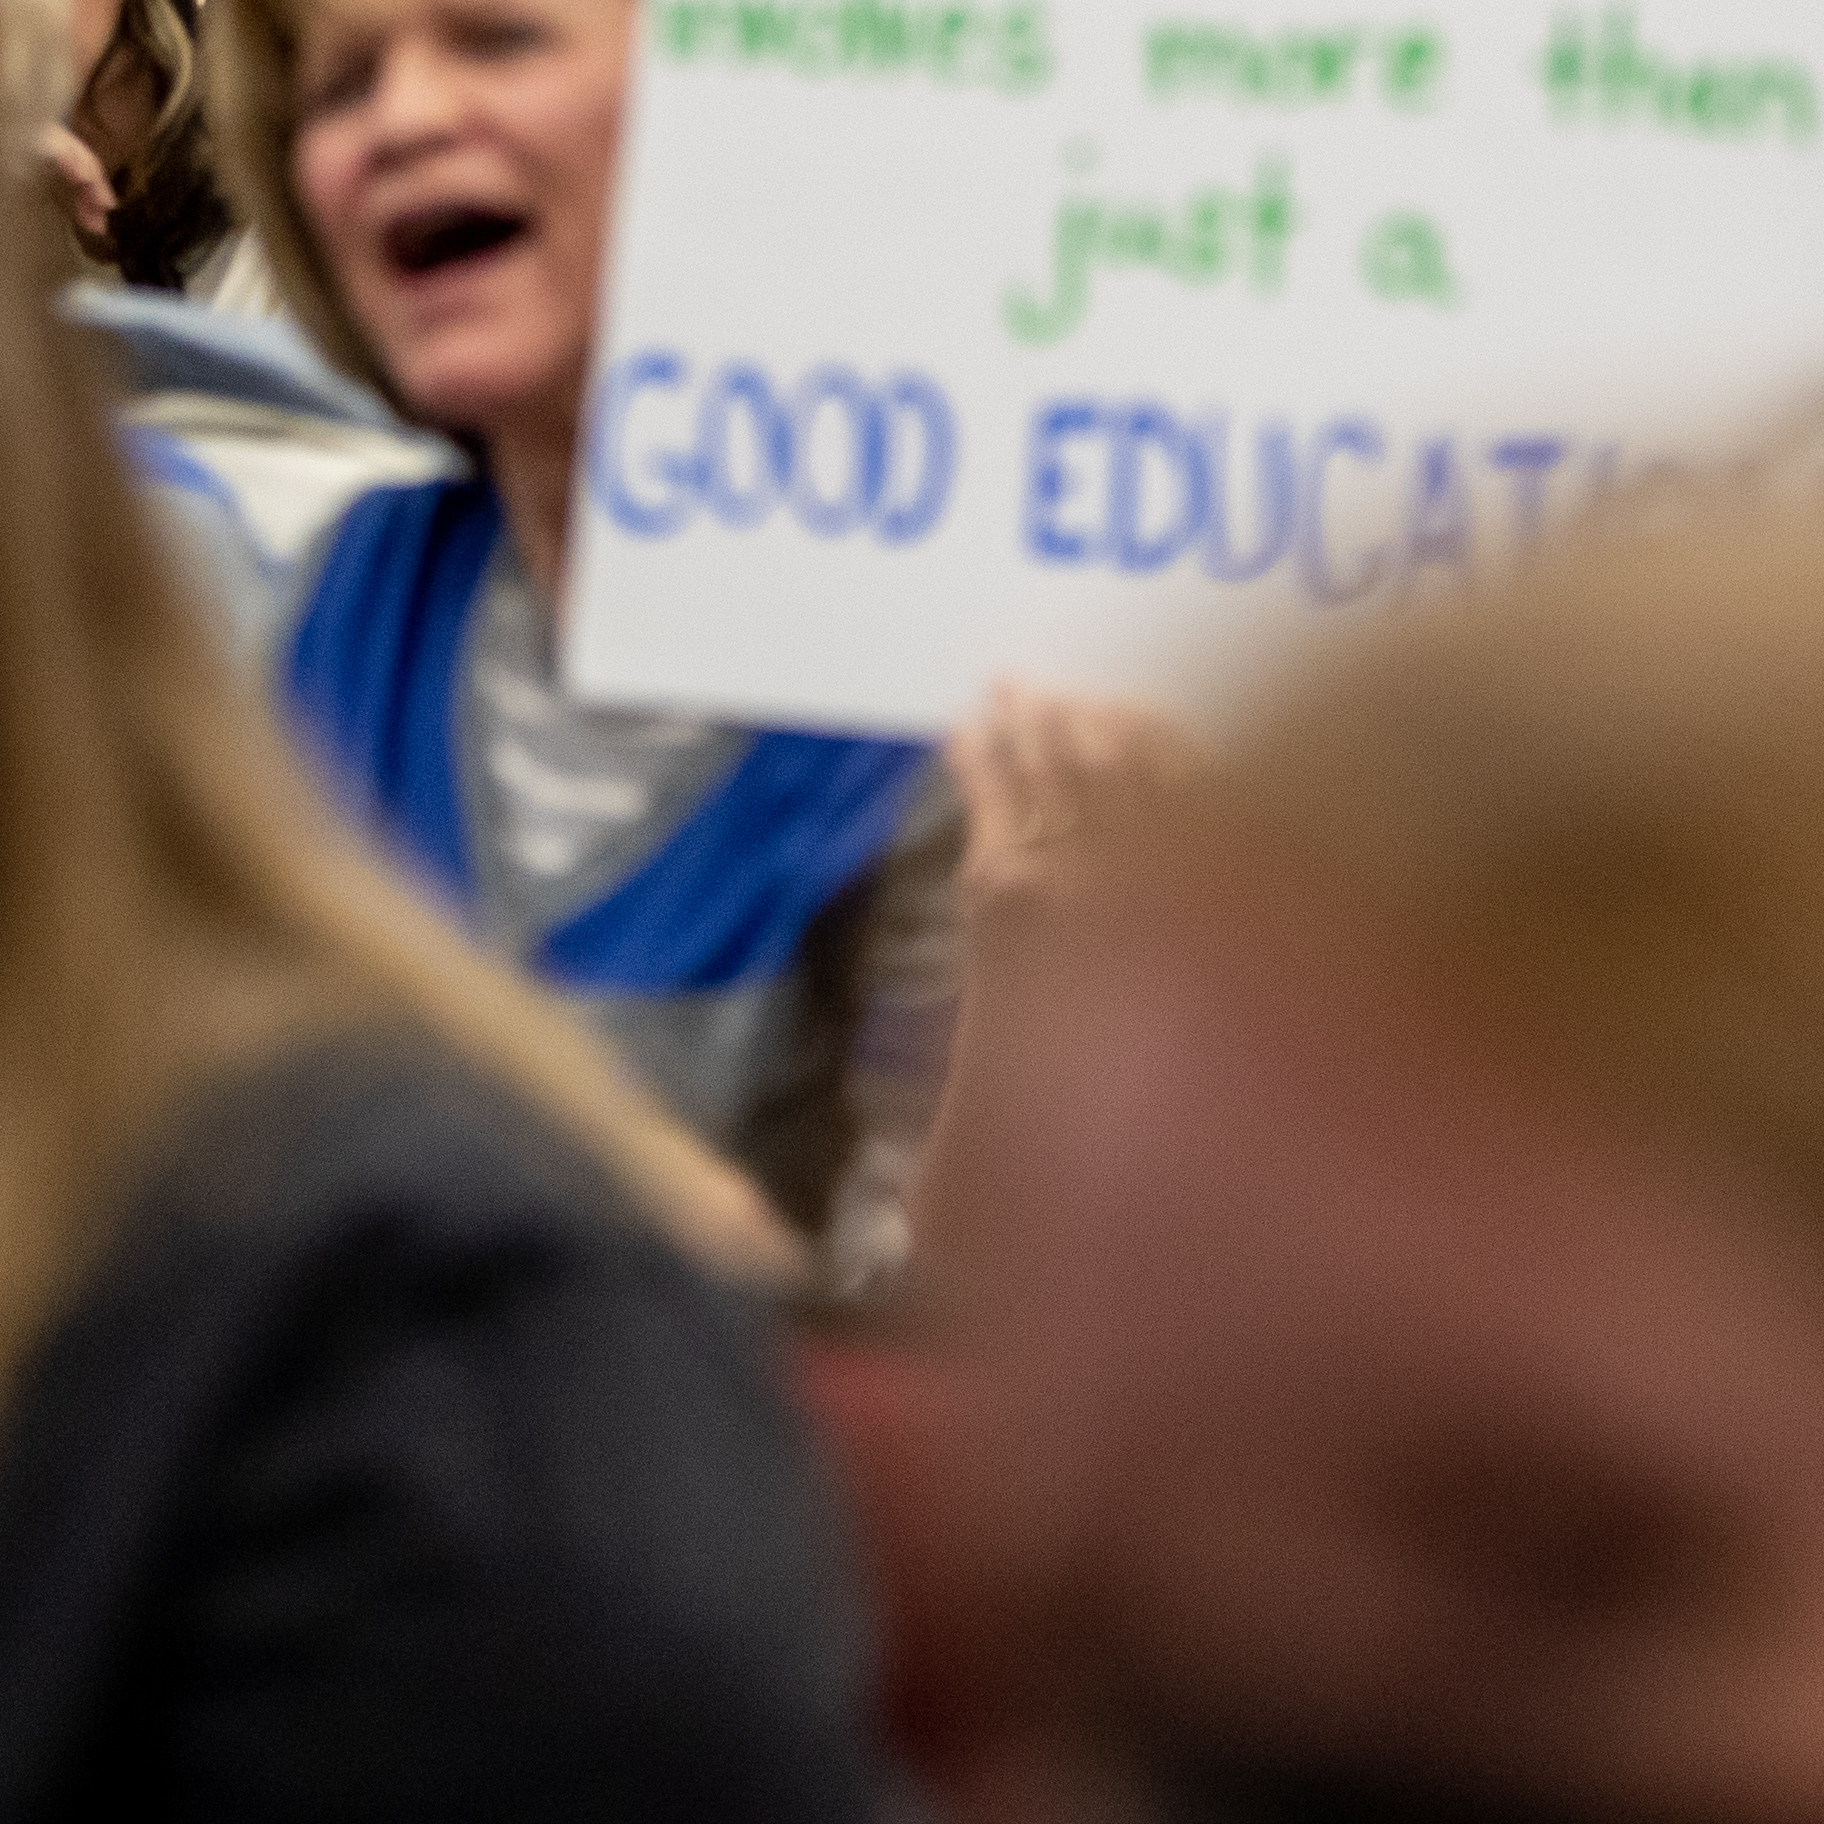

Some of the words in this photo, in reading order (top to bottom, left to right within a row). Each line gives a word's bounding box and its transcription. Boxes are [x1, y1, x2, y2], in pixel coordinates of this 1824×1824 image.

[1141, 14, 1444, 122] more
[1000, 136, 1298, 348] just
[1360, 209, 1470, 313] a
[586, 346, 960, 549] GOOD
[1020, 386, 1636, 610] EDUCAT
